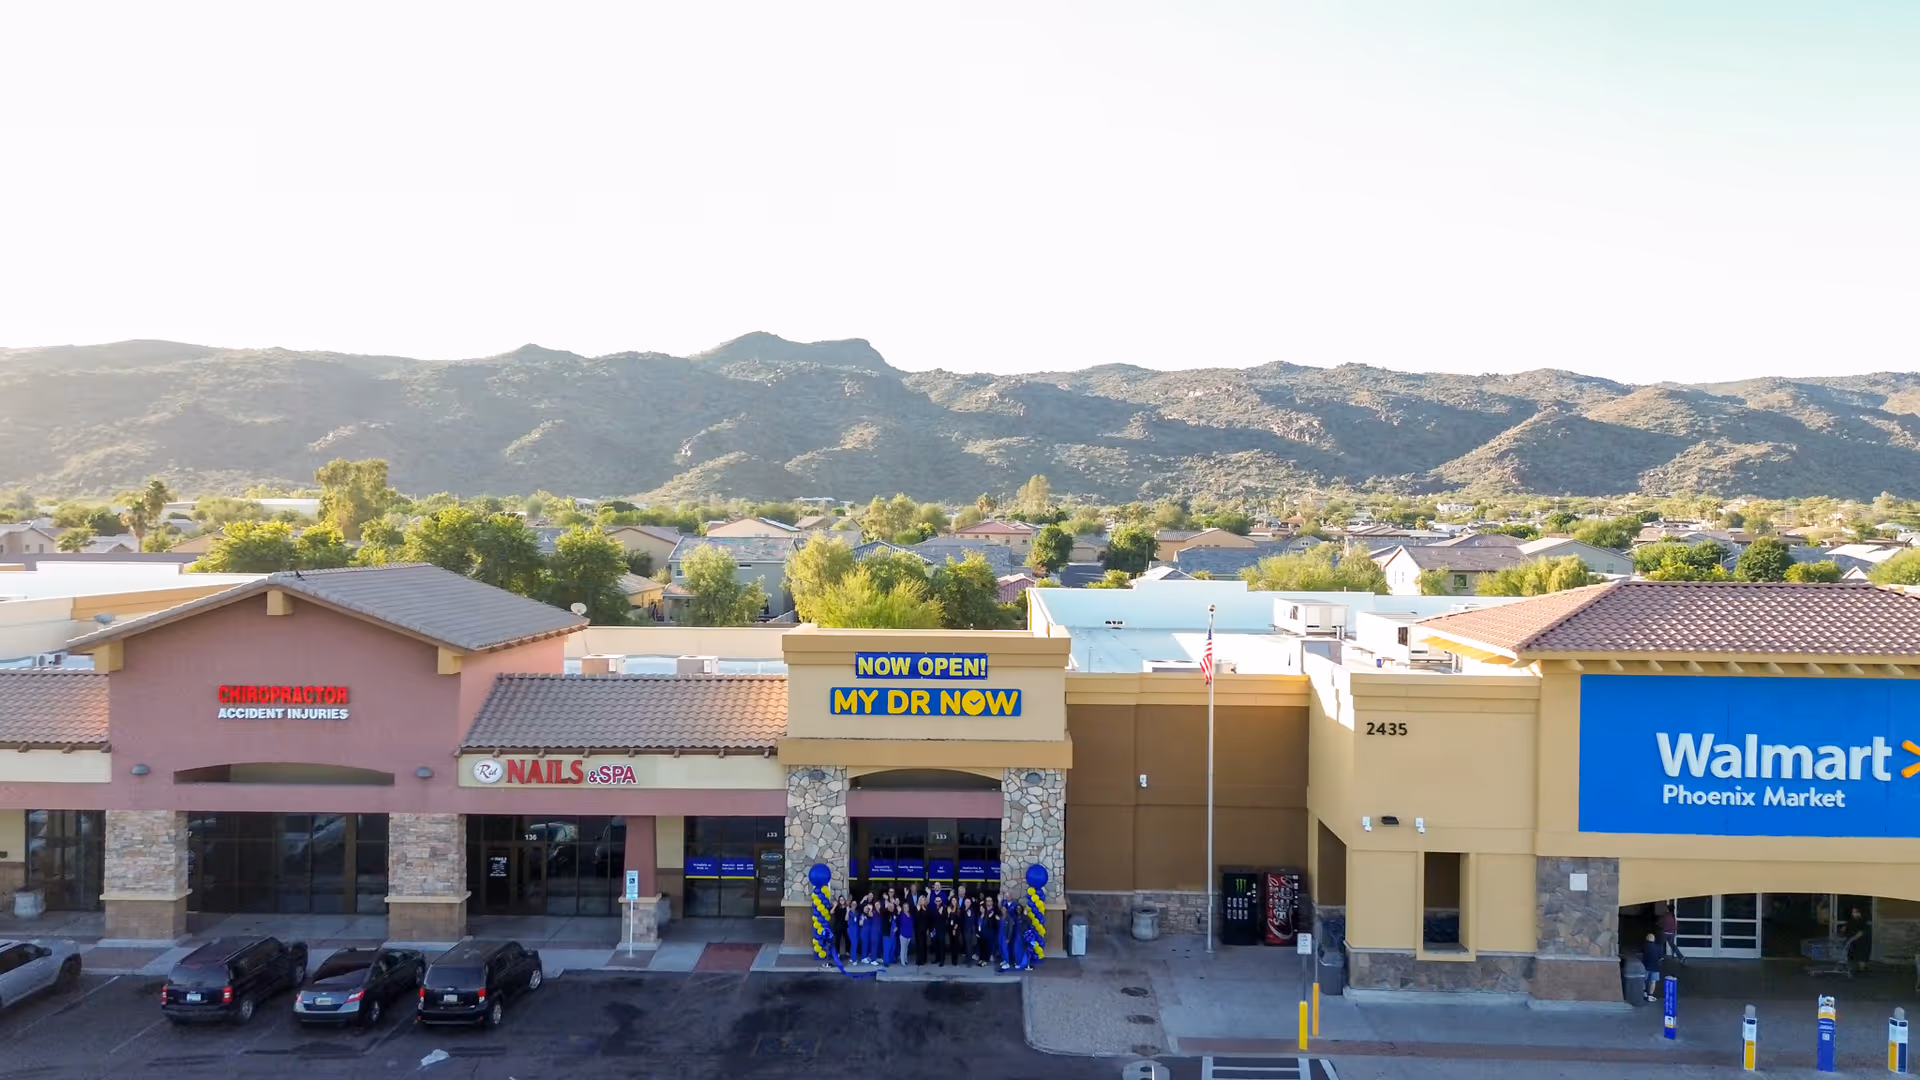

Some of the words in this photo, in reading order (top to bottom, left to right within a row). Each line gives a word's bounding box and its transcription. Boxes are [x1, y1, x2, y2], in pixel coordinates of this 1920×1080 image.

[858, 657, 911, 676] NOW
[918, 657, 987, 677] OPEN!
[218, 685, 349, 704] CHIROPRACTOR
[834, 689, 879, 714] MY
[887, 689, 931, 715] DR
[940, 690, 1018, 716] NOW
[218, 708, 285, 719] ACCIDENT
[287, 708, 350, 720] INJURIES
[1366, 722, 1408, 736] 2435
[1656, 732, 1893, 782] Walmart
[505, 759, 584, 785] NAILS
[1662, 784, 1755, 805] Phoenix
[1763, 786, 1846, 808] Market
